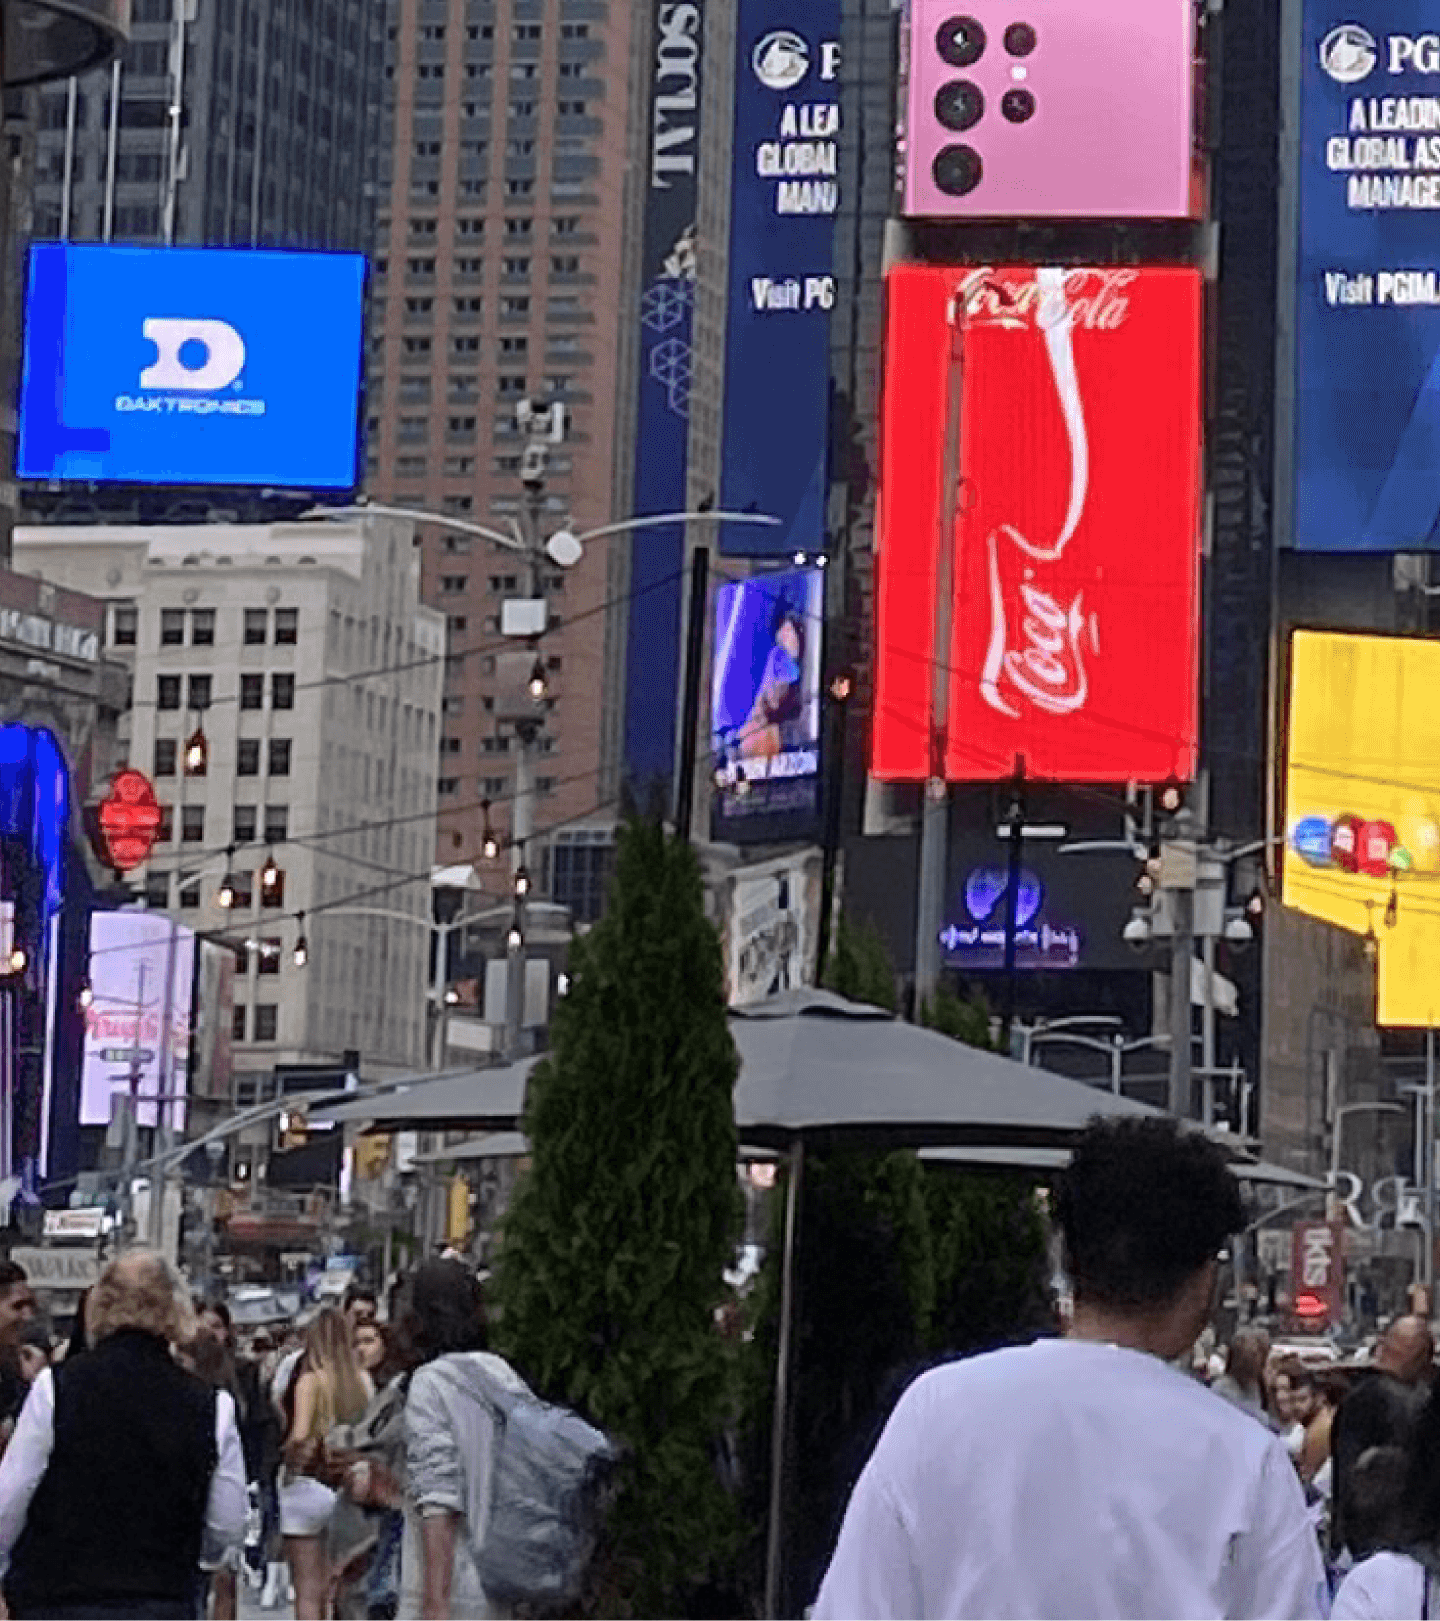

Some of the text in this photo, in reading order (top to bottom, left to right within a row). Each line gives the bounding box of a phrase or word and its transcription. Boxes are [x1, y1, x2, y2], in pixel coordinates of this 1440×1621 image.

[781, 104, 797, 138] A
[1348, 97, 1366, 130] A
[1326, 137, 1410, 170] GLOBAL
[752, 278, 801, 311] Visit
[1324, 273, 1373, 305] Visit
